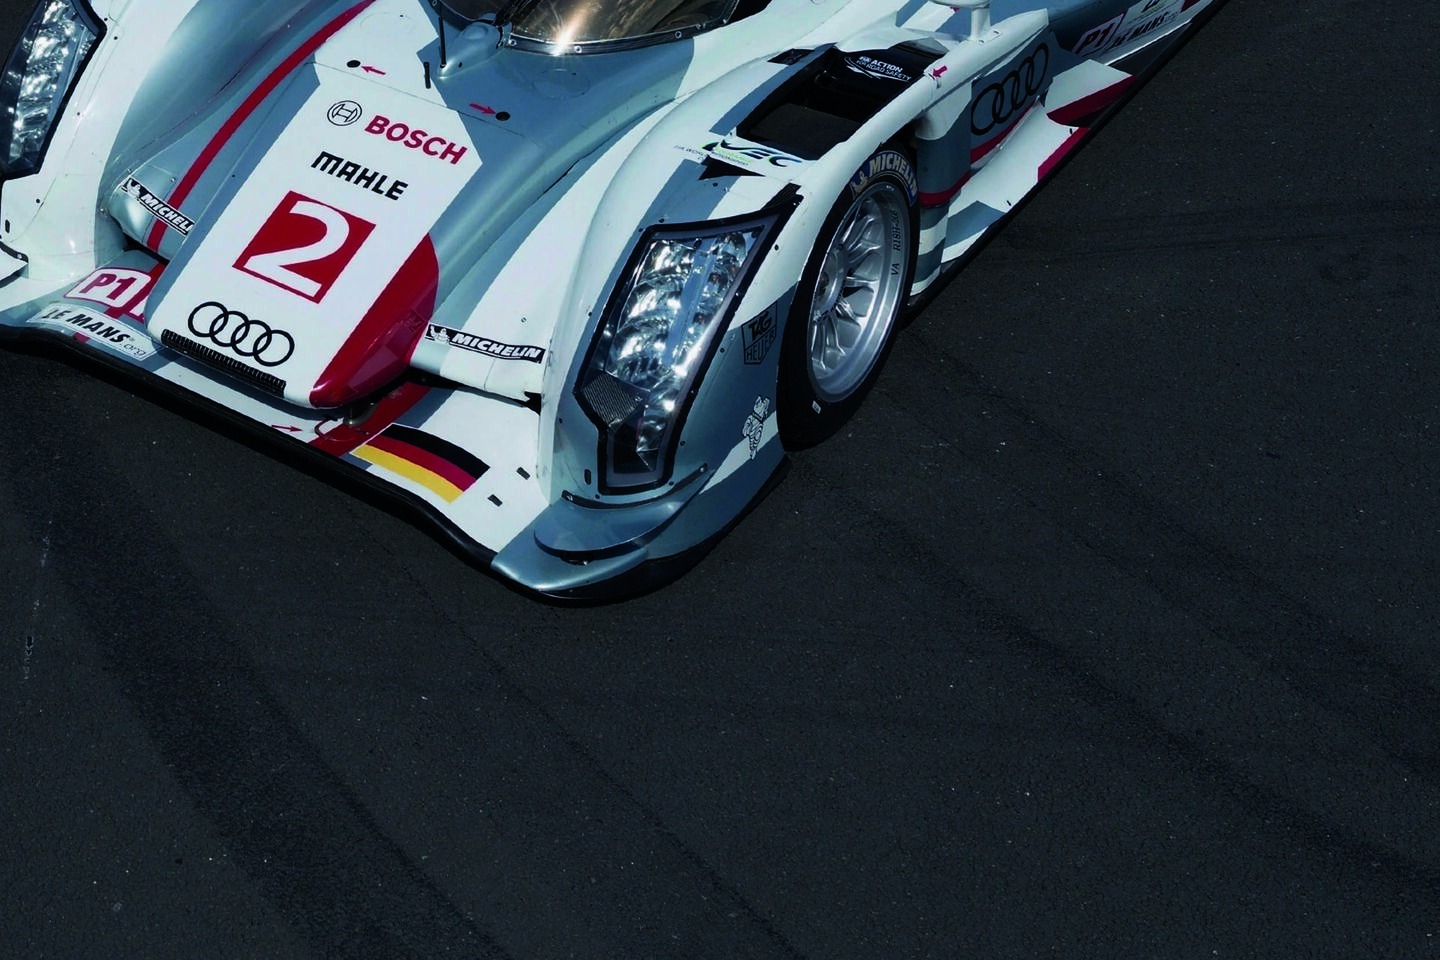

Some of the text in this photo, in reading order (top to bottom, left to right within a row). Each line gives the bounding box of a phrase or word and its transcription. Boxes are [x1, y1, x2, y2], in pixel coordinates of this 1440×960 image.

[1074, 22, 1115, 54] P1
[866, 63, 885, 72] ROAD
[885, 69, 912, 80] SAFETY
[870, 60, 903, 73] ACTION
[364, 114, 468, 165] BOSCH
[311, 151, 408, 201] MAHLE
[869, 153, 918, 197] MICHELIN
[242, 200, 350, 298] 2
[79, 273, 138, 300] P1
[748, 310, 773, 340] TAG
[452, 332, 542, 358] MICHELIN
[746, 330, 775, 361] HEUER
